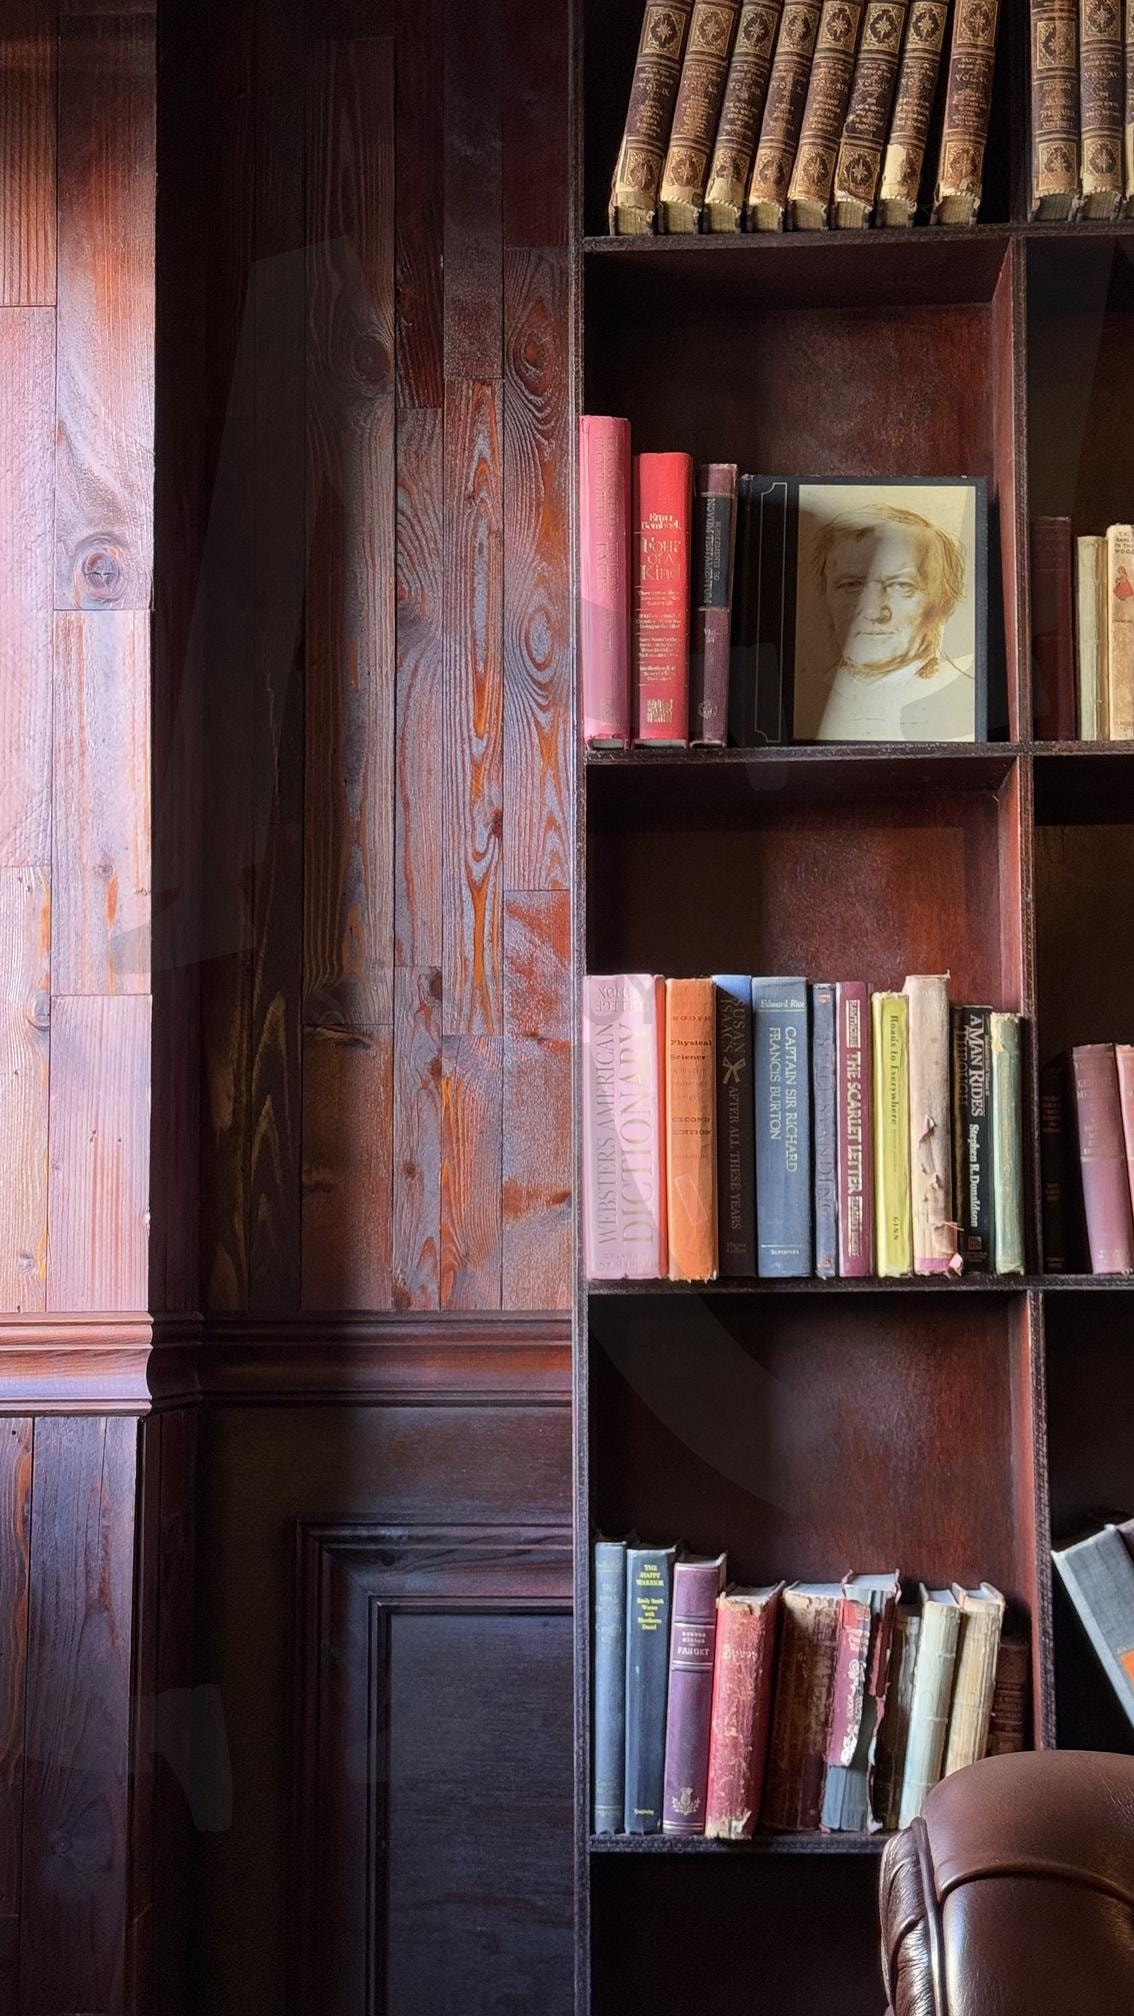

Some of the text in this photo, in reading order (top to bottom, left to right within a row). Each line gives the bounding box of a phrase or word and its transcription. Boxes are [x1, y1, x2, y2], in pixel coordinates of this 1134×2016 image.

[640, 564, 681, 581] Kind
[703, 498, 716, 604] NOVUM TESTAMENTUM
[671, 1039, 712, 1047] Physical
[720, 999, 732, 1052] ISAACS
[732, 999, 746, 1053] SUSAN
[890, 1015, 899, 1047] Roads
[890, 1050, 898, 1062] to
[956, 1024, 969, 1105] THROUGH
[968, 1014, 985, 1117] A MAN RIDES
[728, 1086, 740, 1124] AFTER
[769, 1027, 782, 1140] FRANCIS BURTON
[785, 1026, 798, 1173] CAPTAIN SIR RICHARD
[889, 1064, 899, 1126] Everywhere
[595, 1023, 617, 1245] WEBSTER'S AMERICAN
[619, 1023, 655, 1245] DICTIONARY
[729, 1125, 740, 1149] ALL
[847, 1051, 862, 1193] THE SCARLET LETTER
[967, 1123, 980, 1162] Stephen
[730, 1151, 741, 1192] THESE
[730, 1194, 742, 1230] YEARS
[969, 1174, 980, 1227] Donaldson
